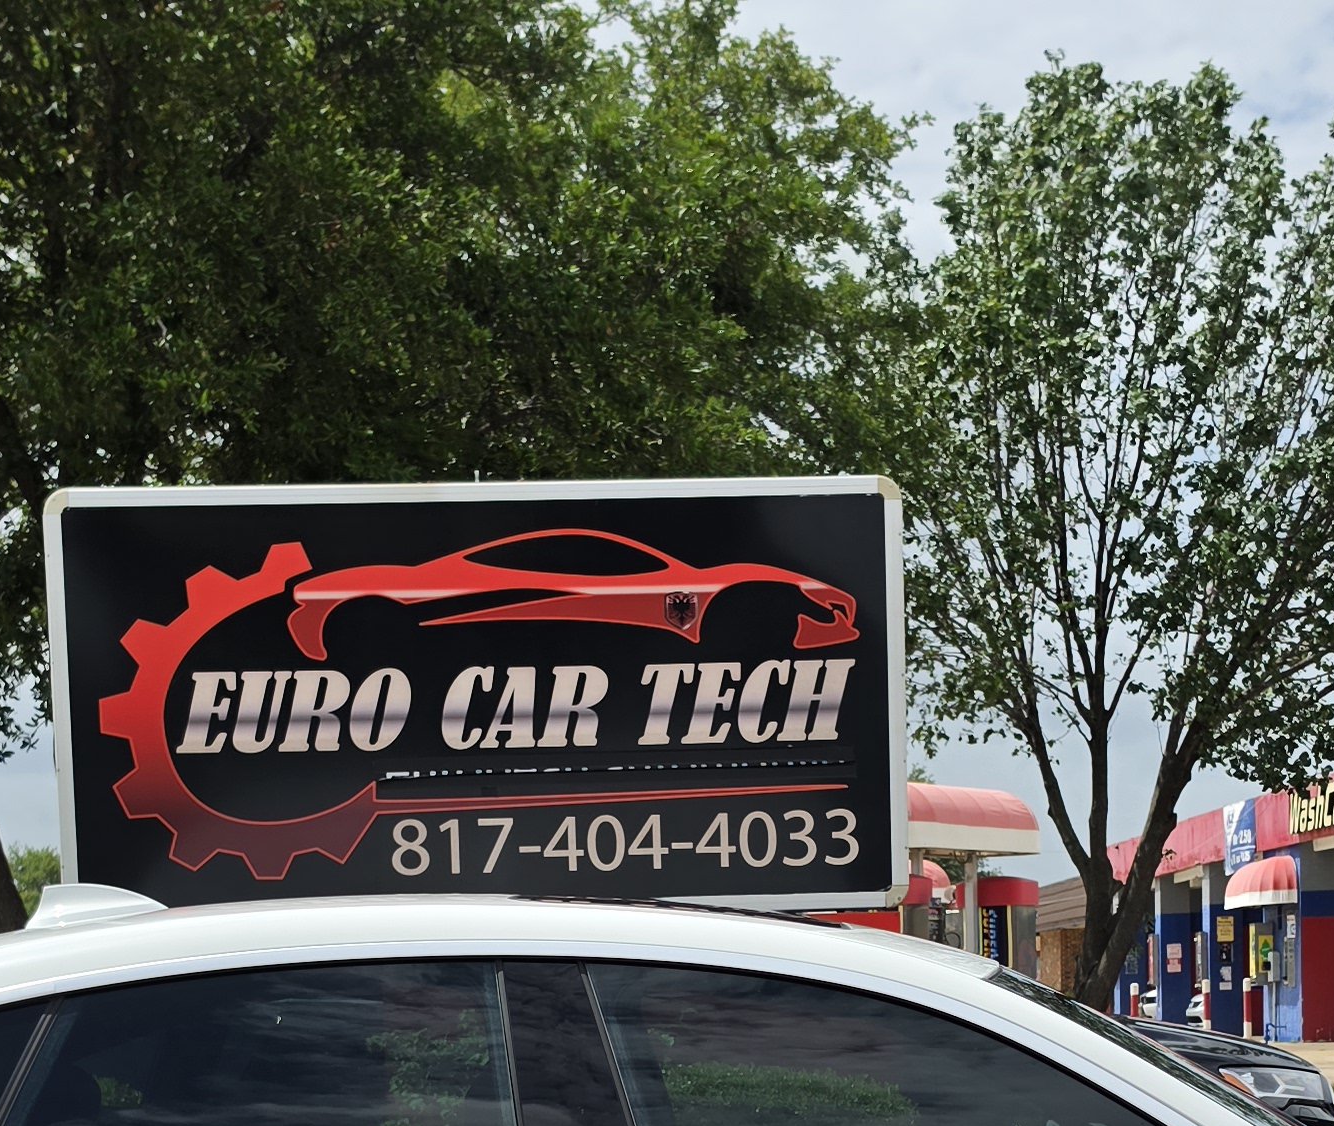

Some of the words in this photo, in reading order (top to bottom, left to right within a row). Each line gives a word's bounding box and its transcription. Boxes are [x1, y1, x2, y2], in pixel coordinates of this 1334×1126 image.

[175, 667, 412, 755] EURO
[441, 664, 609, 750] CAR
[639, 658, 856, 747] TECH
[391, 808, 860, 876] 817-404-4033
